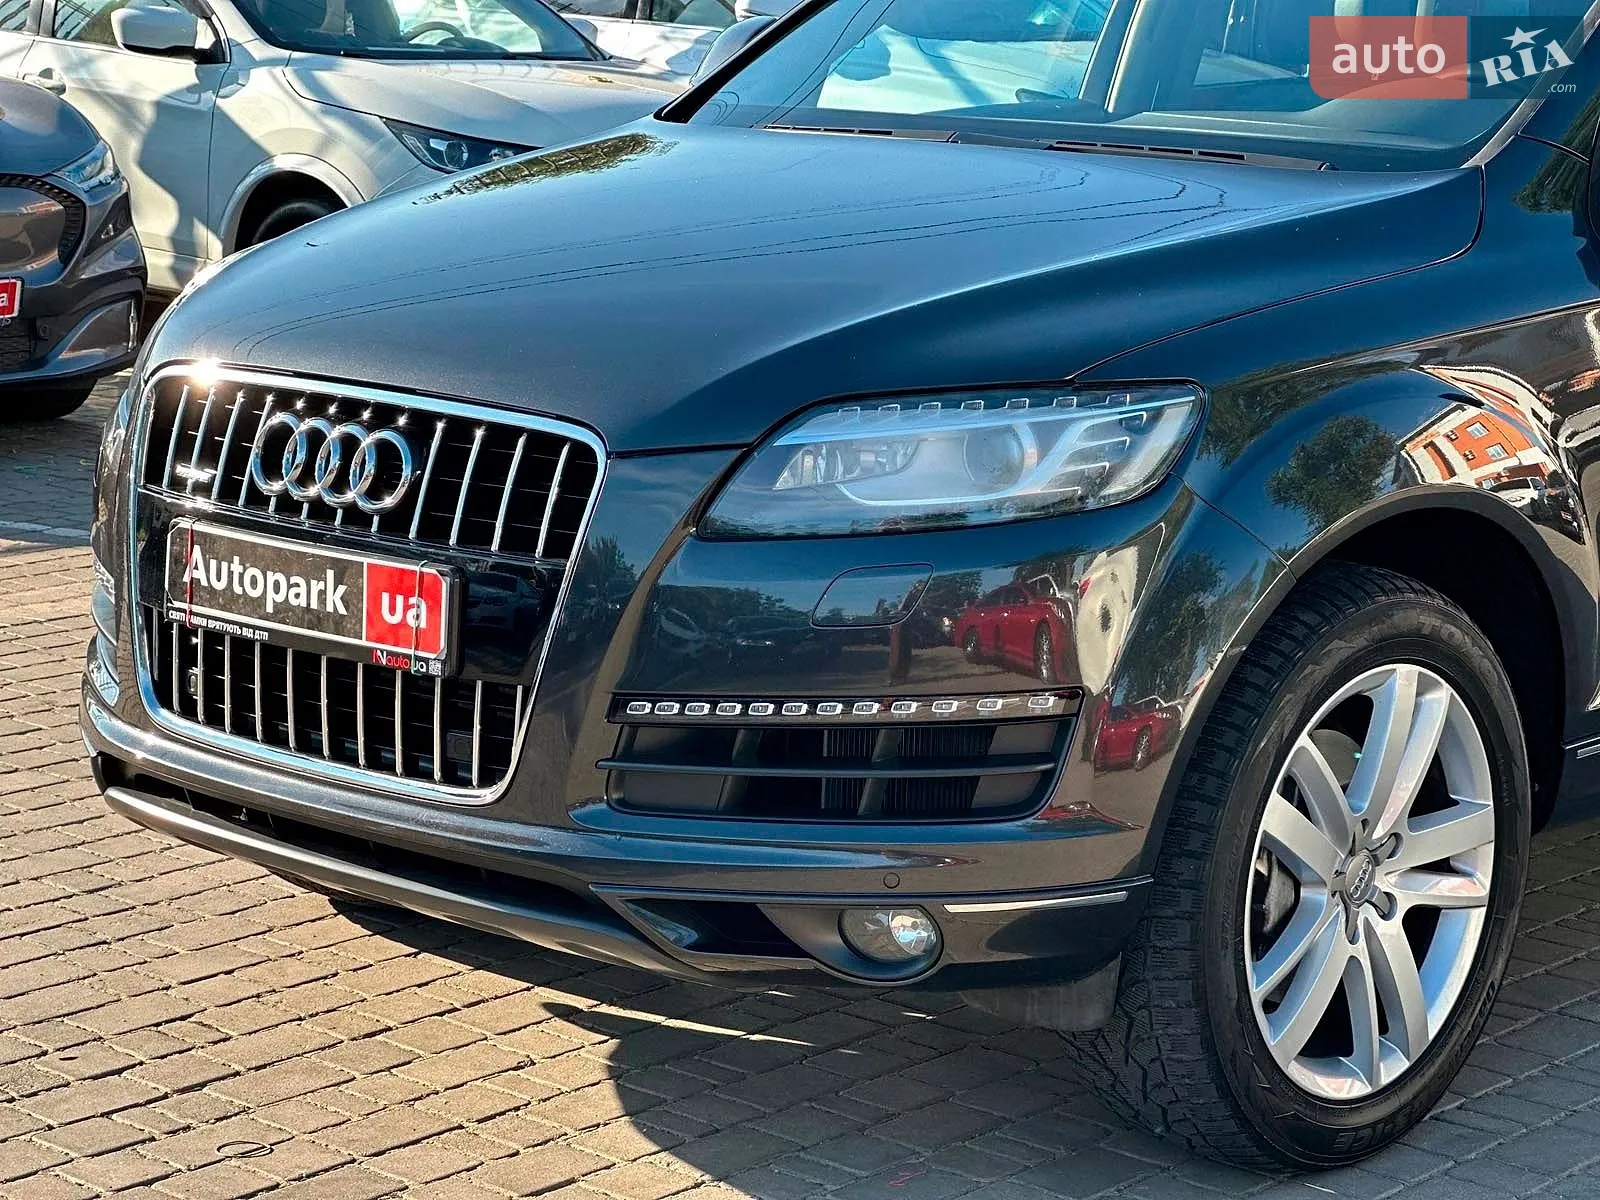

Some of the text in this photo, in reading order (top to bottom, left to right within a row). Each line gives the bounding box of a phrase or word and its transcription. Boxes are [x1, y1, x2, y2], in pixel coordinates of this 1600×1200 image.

[182, 544, 427, 629] Autopark ua
[187, 613, 208, 627] АМКИ
[207, 618, 242, 635] ВРЯТУЮТЬ
[254, 630, 269, 641] ДТП
